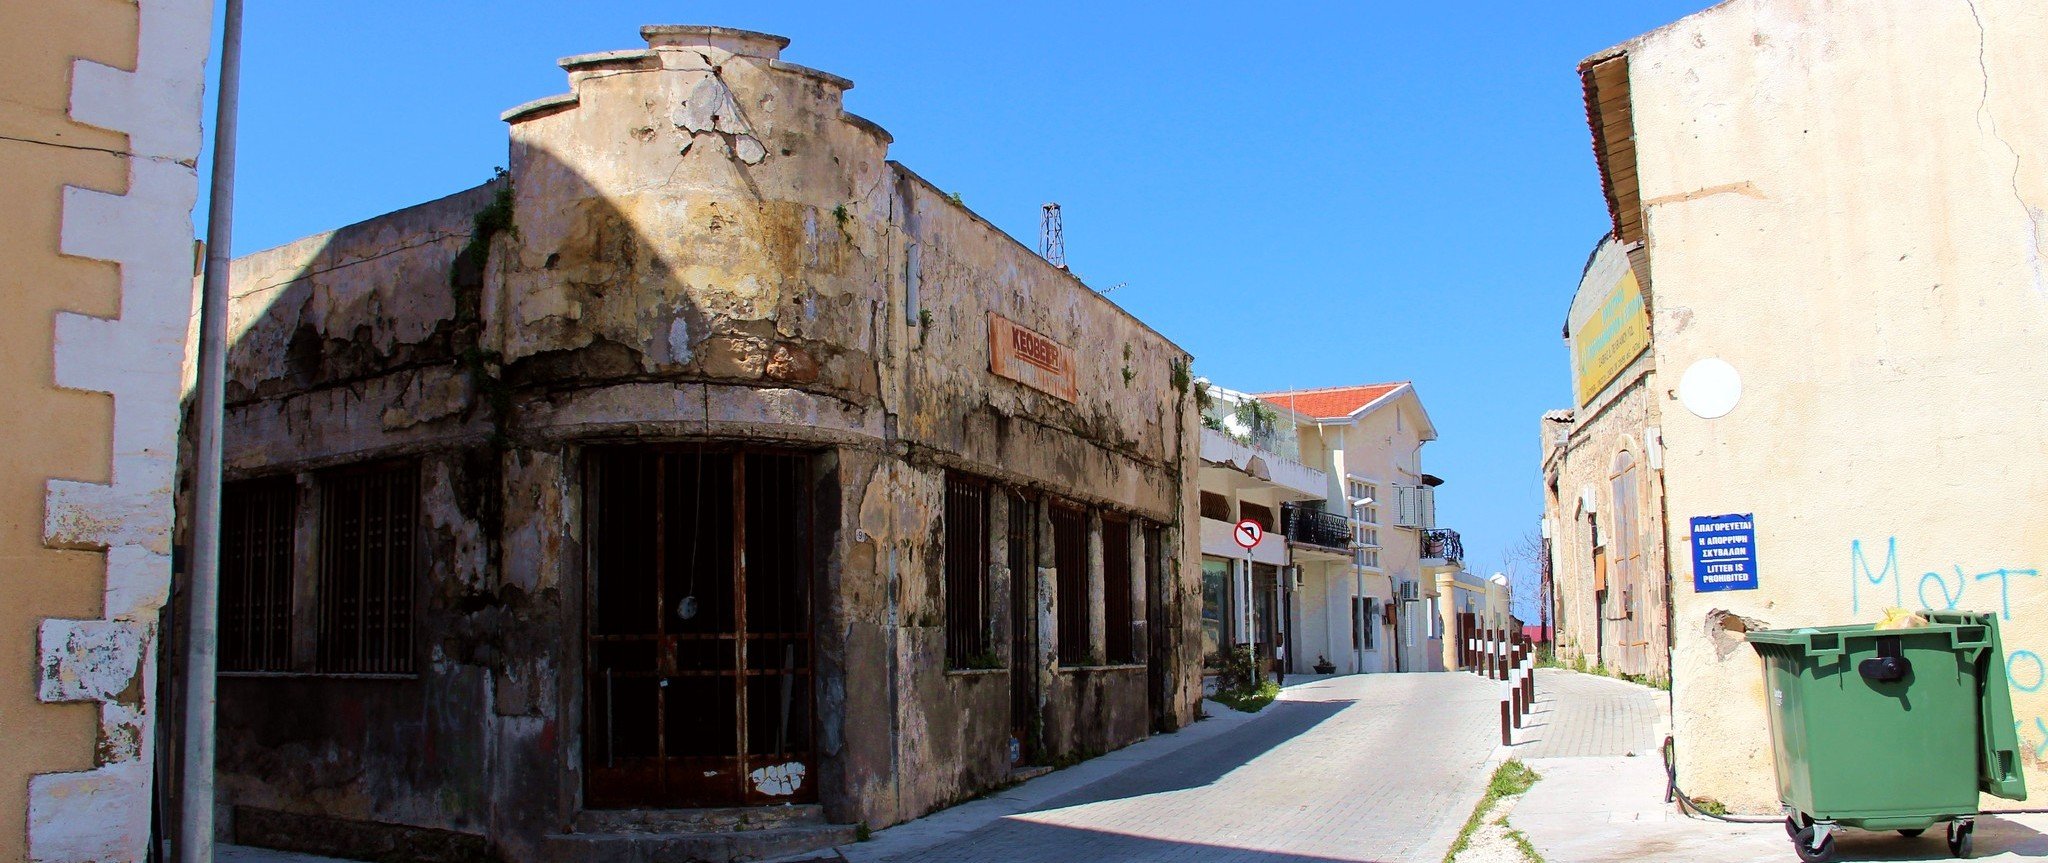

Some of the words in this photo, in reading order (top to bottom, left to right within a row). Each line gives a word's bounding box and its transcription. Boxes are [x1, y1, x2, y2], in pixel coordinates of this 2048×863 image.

[1694, 521, 1752, 532] ΑΠΑΓΟΡΕΥΕΤΑΙ
[1698, 537, 1706, 546] Η
[1707, 535, 1748, 545] ΑΠΟΡΡΙΨΗ
[1702, 547, 1746, 557] ΣΚΥΒΑΛΩΝ
[1707, 564, 1733, 573] LITTER
[1735, 563, 1744, 571] IS
[1703, 573, 1749, 583] PROHIBITED
